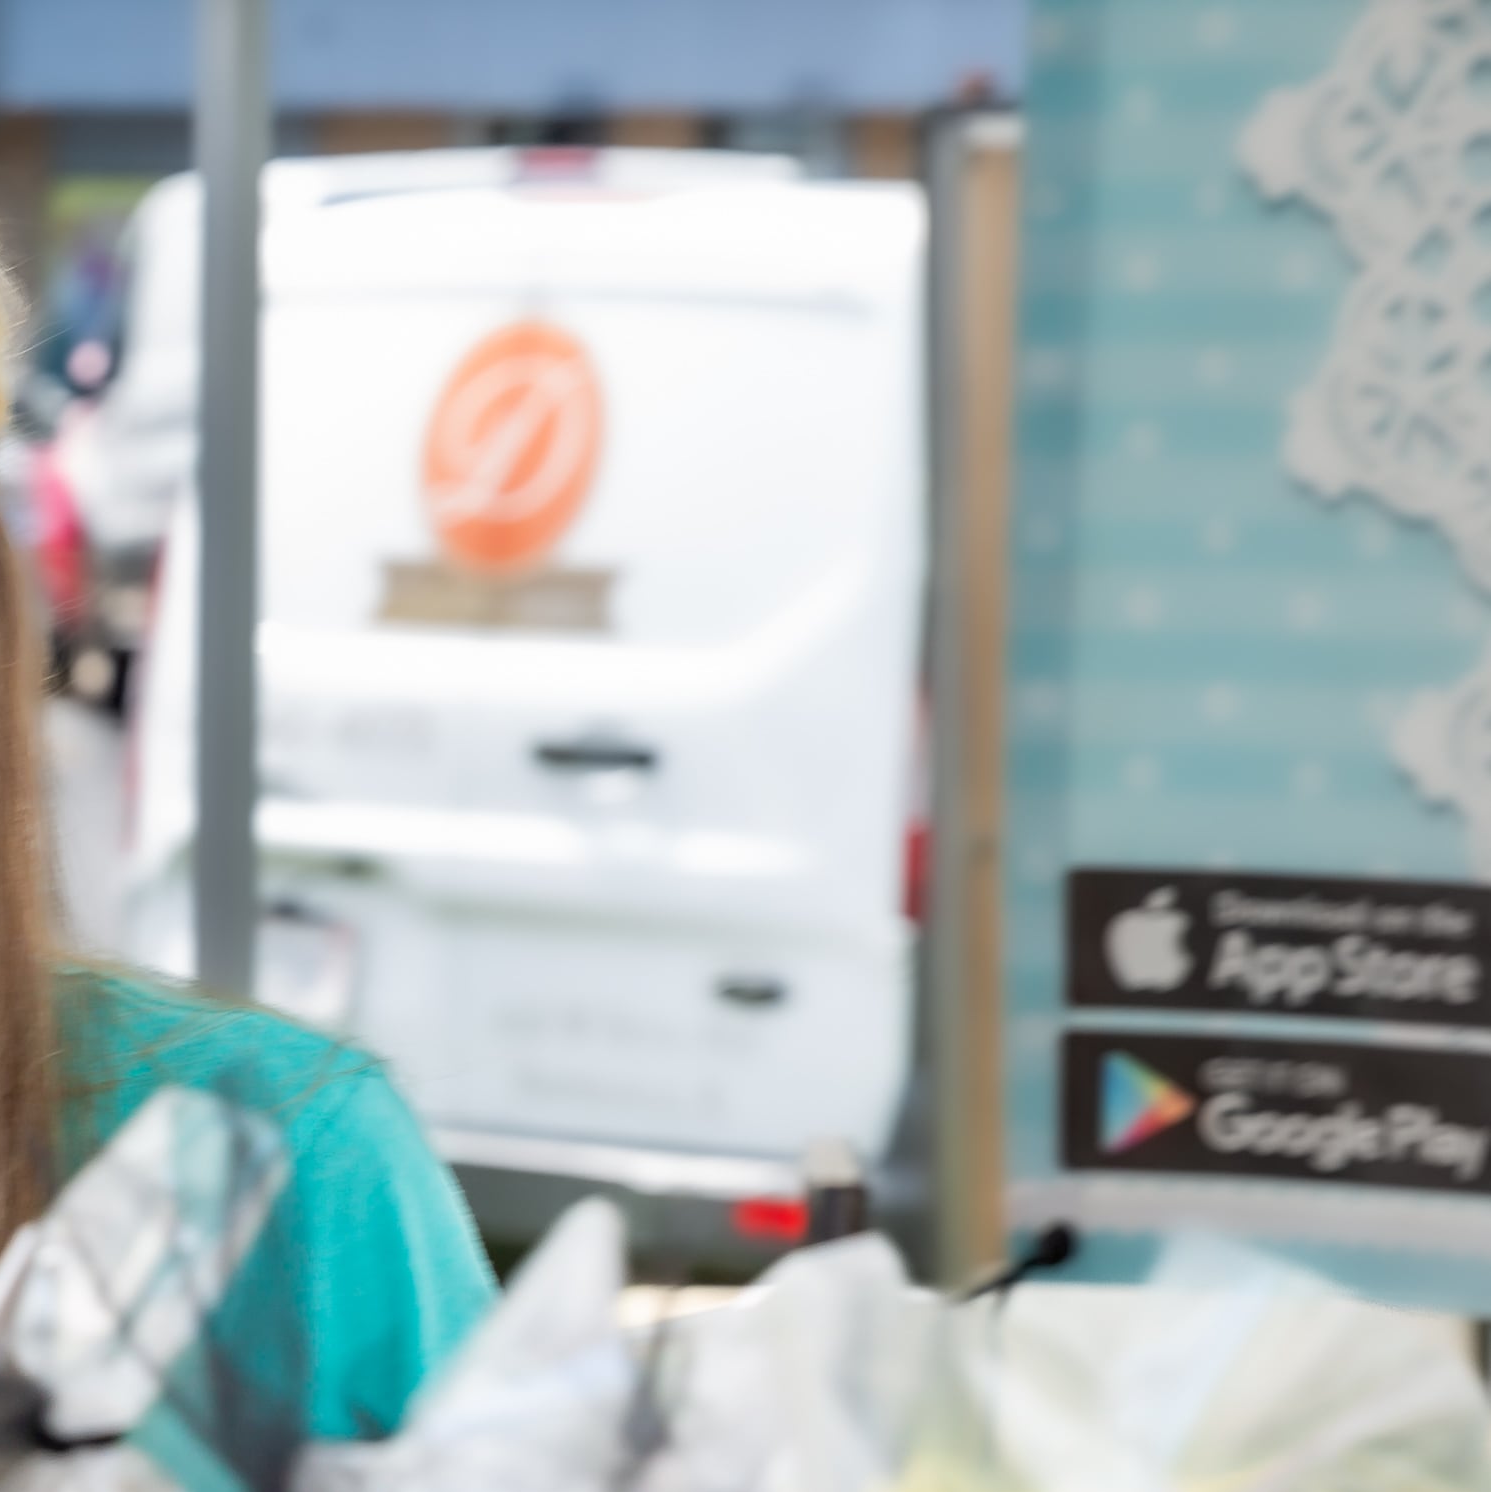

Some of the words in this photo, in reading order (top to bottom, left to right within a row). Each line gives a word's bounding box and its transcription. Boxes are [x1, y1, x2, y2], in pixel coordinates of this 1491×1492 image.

[1207, 928, 1329, 1007] App
[1328, 933, 1483, 1005] Store
[1195, 1091, 1381, 1174] Google
[1382, 1102, 1489, 1184] Play
